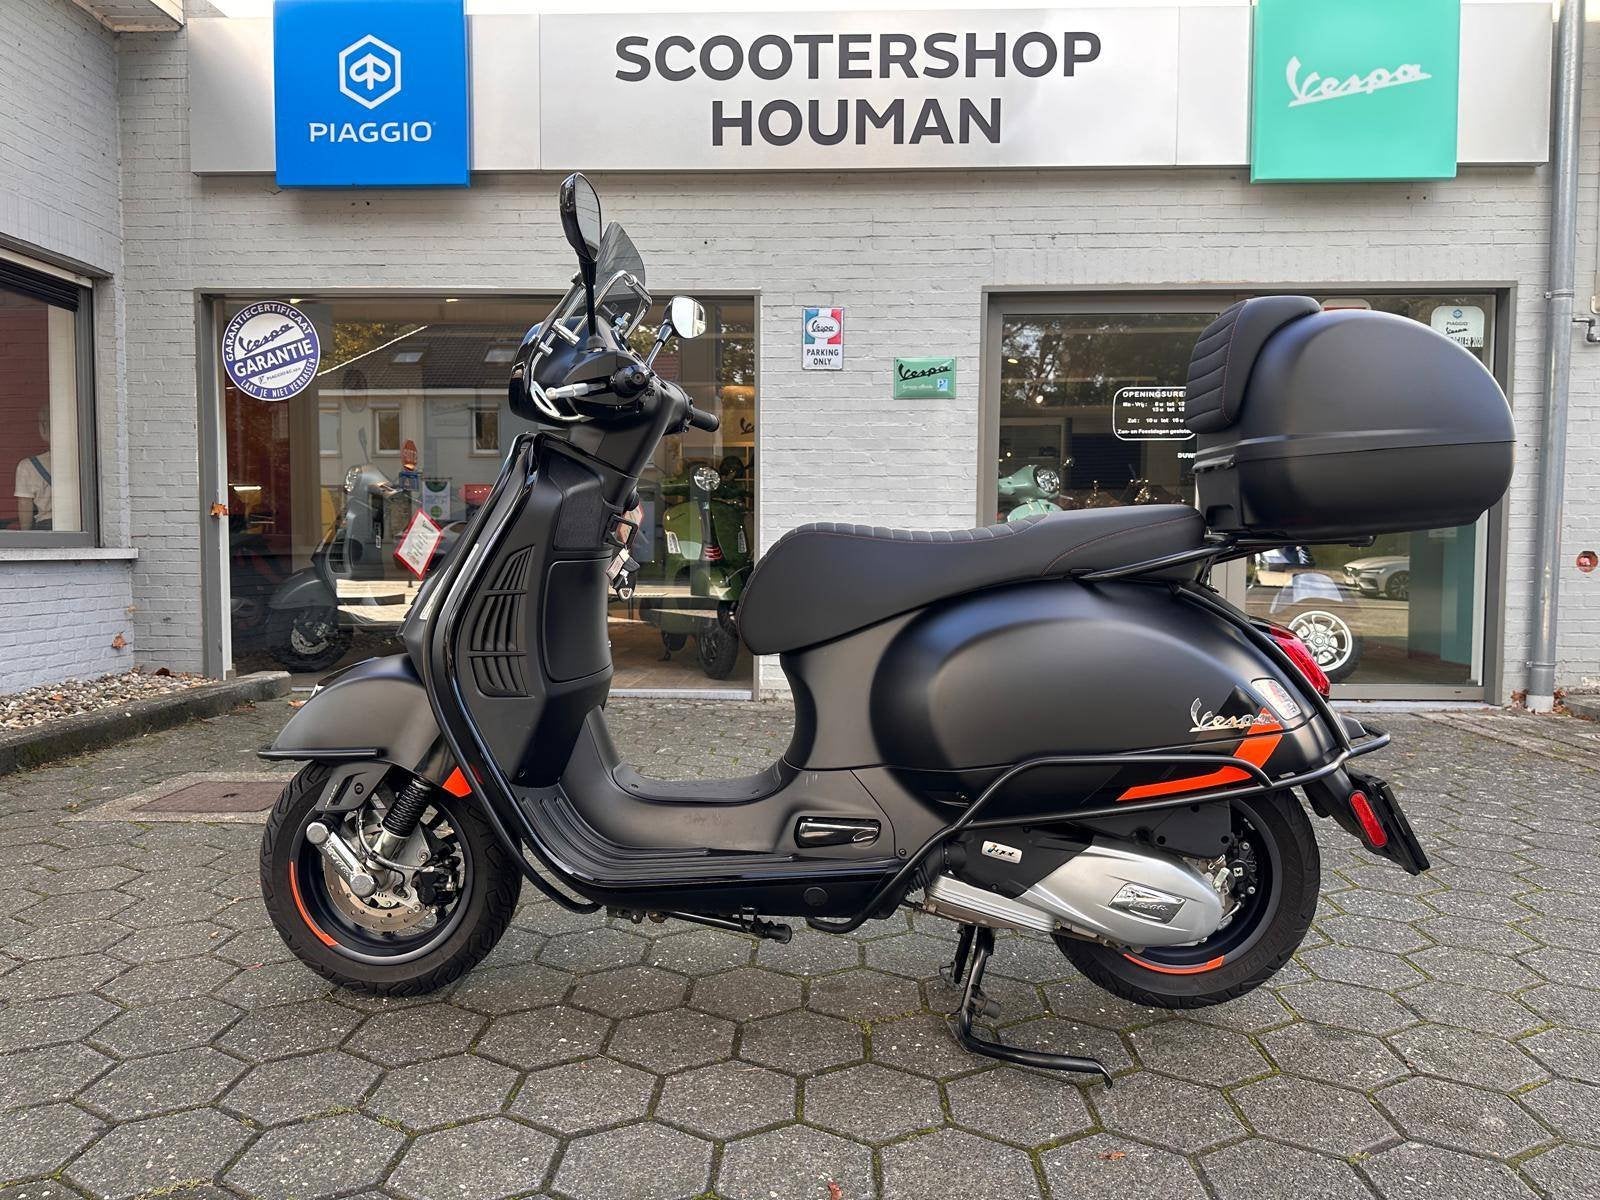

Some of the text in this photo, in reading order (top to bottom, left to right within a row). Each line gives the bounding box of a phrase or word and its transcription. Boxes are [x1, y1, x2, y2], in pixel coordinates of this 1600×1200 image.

[615, 31, 1102, 82] SCOOTERSHOP
[1286, 55, 1432, 108] Vespa
[308, 120, 433, 143] PIAGGIO
[711, 97, 1002, 147] HOUMAN
[225, 303, 312, 362] GARANTIECERTIFICAAT
[238, 324, 295, 356] Vespa
[811, 319, 836, 333] Vespa
[233, 339, 315, 378] GARANTIE
[806, 348, 840, 357] PARKING
[813, 358, 833, 367] ONLY
[240, 379, 258, 395] LAAT
[260, 388, 268, 398] JE
[272, 387, 290, 398] NIET
[288, 358, 316, 390] VERRASSEN
[897, 362, 952, 382] Vespa
[1188, 697, 1281, 733] Vespa
